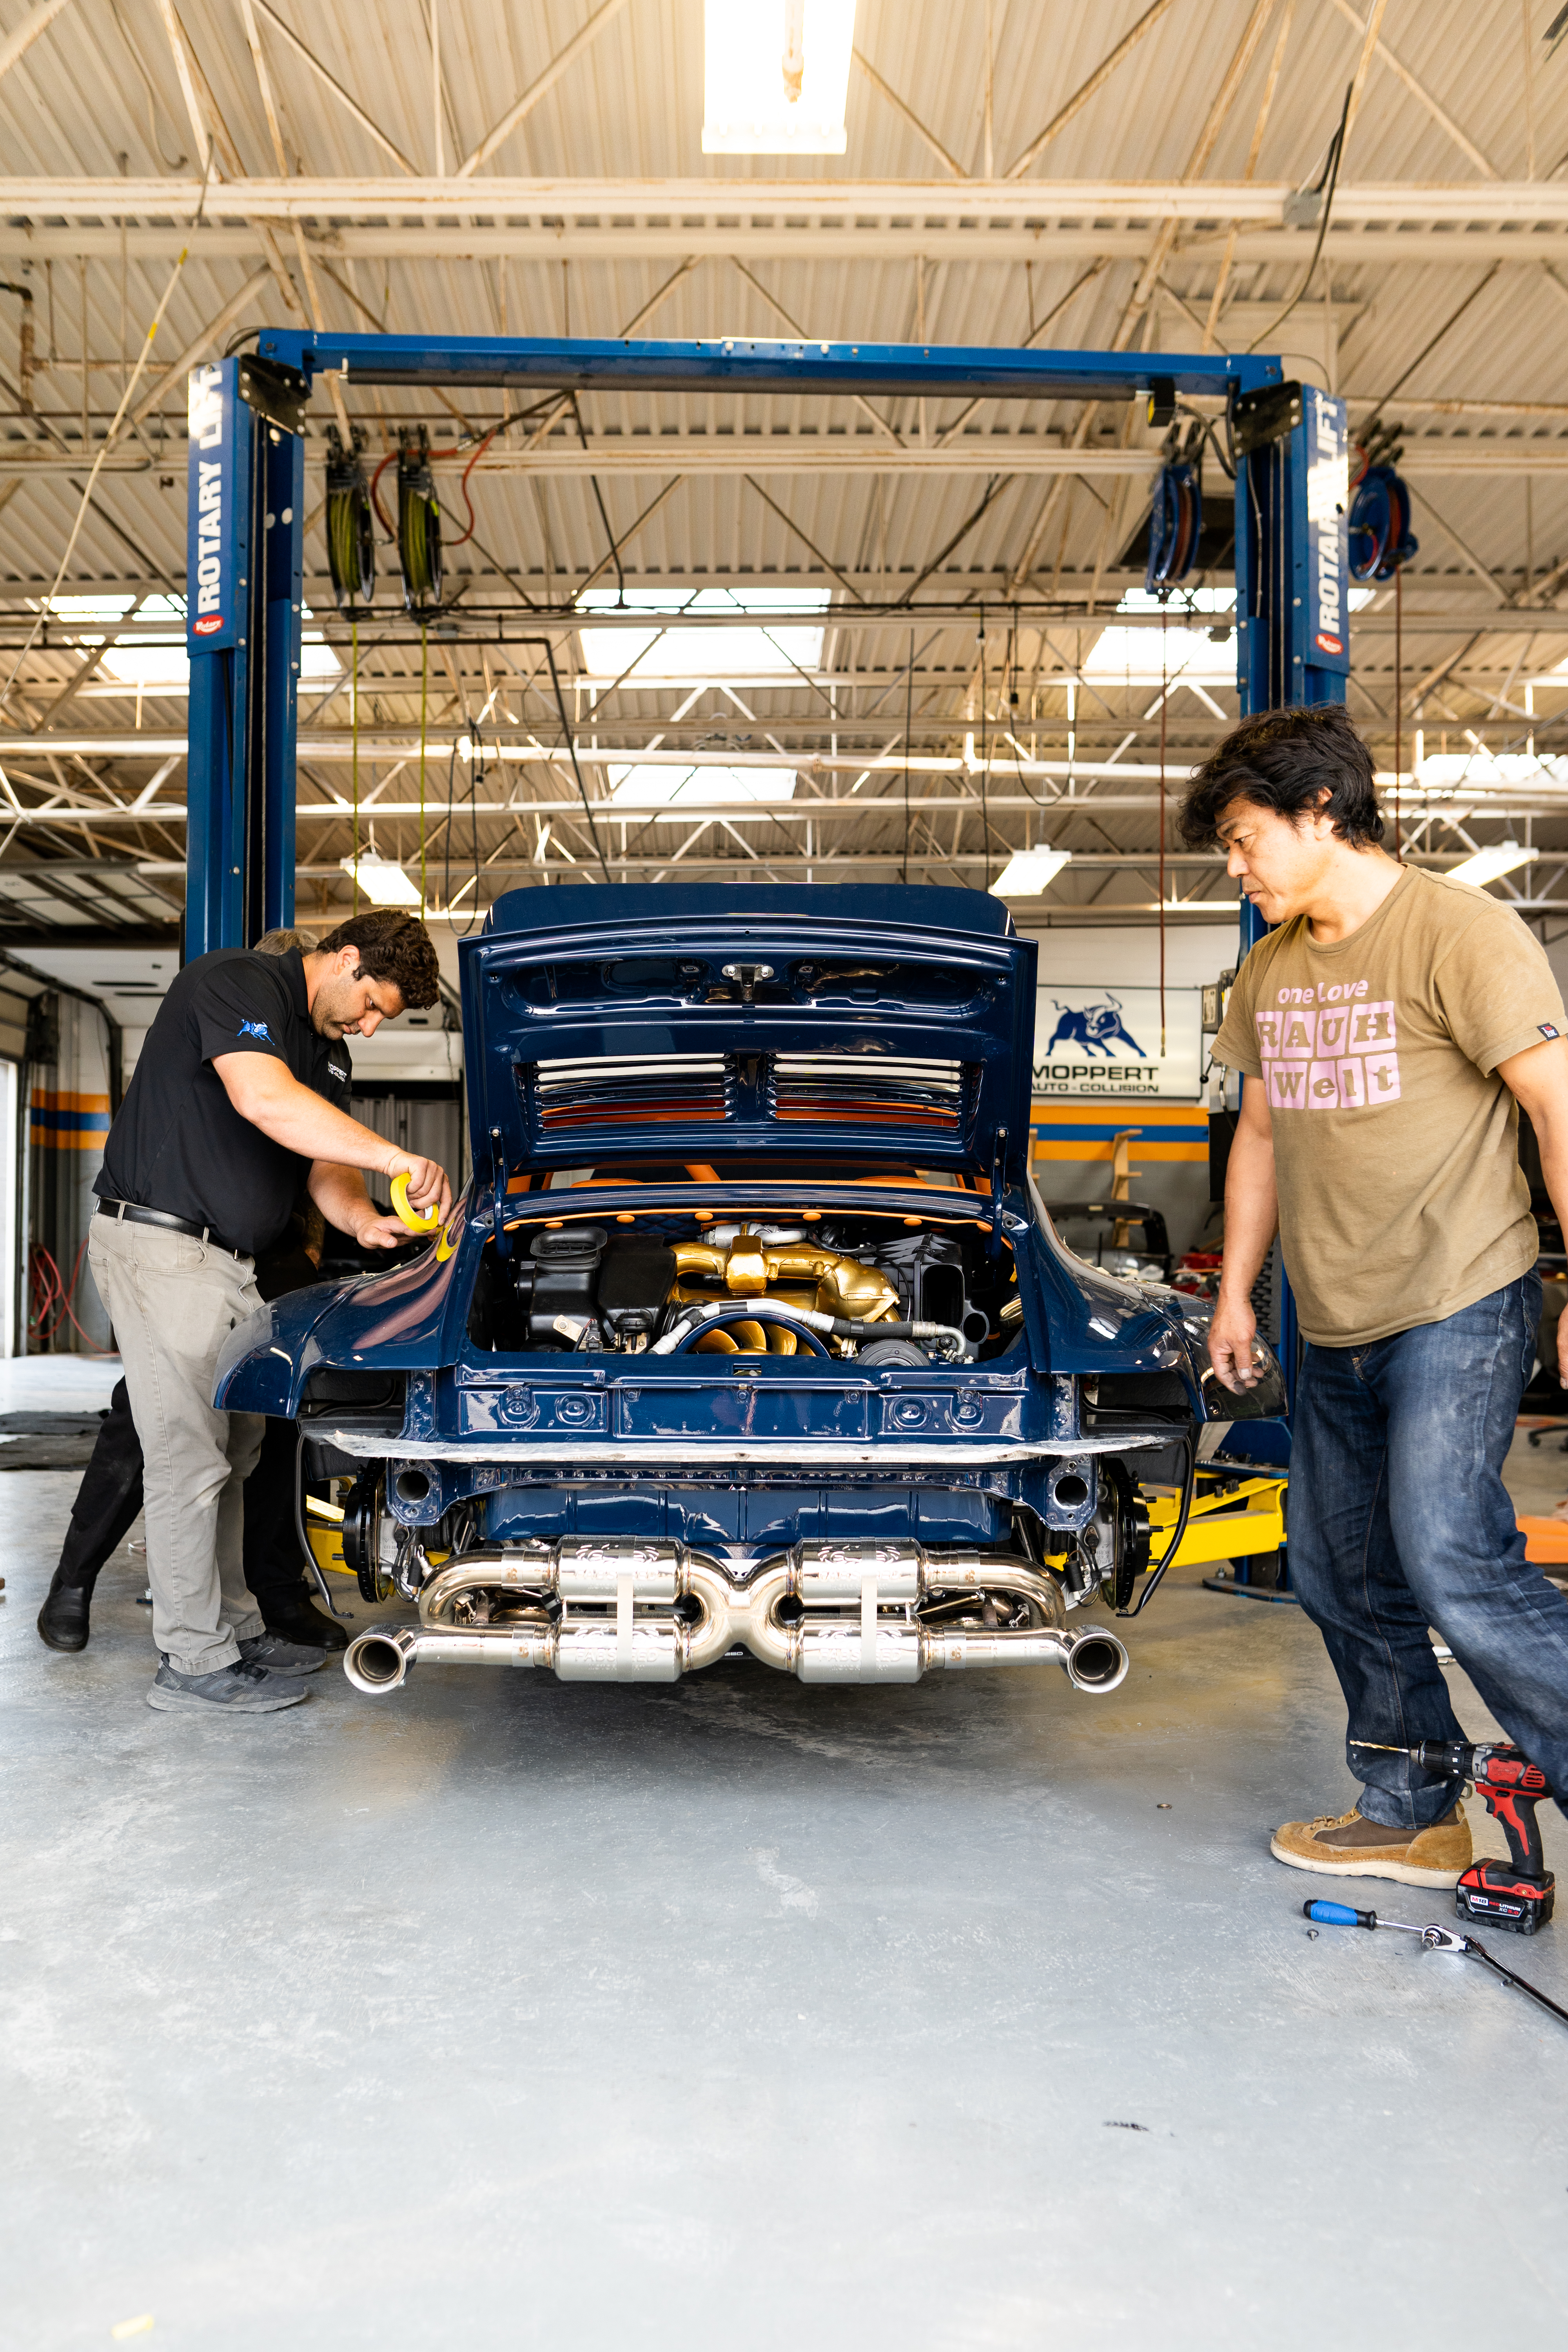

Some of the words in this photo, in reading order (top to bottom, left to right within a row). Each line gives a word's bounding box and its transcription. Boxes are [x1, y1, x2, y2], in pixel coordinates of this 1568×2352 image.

[198, 461, 222, 614] ROTARY
[1318, 488, 1340, 634] ROTAR
[1258, 1012, 1392, 1048] RAUH
[1033, 1065, 1159, 1080] MOPPERT
[1080, 1083, 1159, 1093] COLLISION
[575, 1648, 659, 1662] FABSED
[819, 1648, 902, 1662] FABSED
